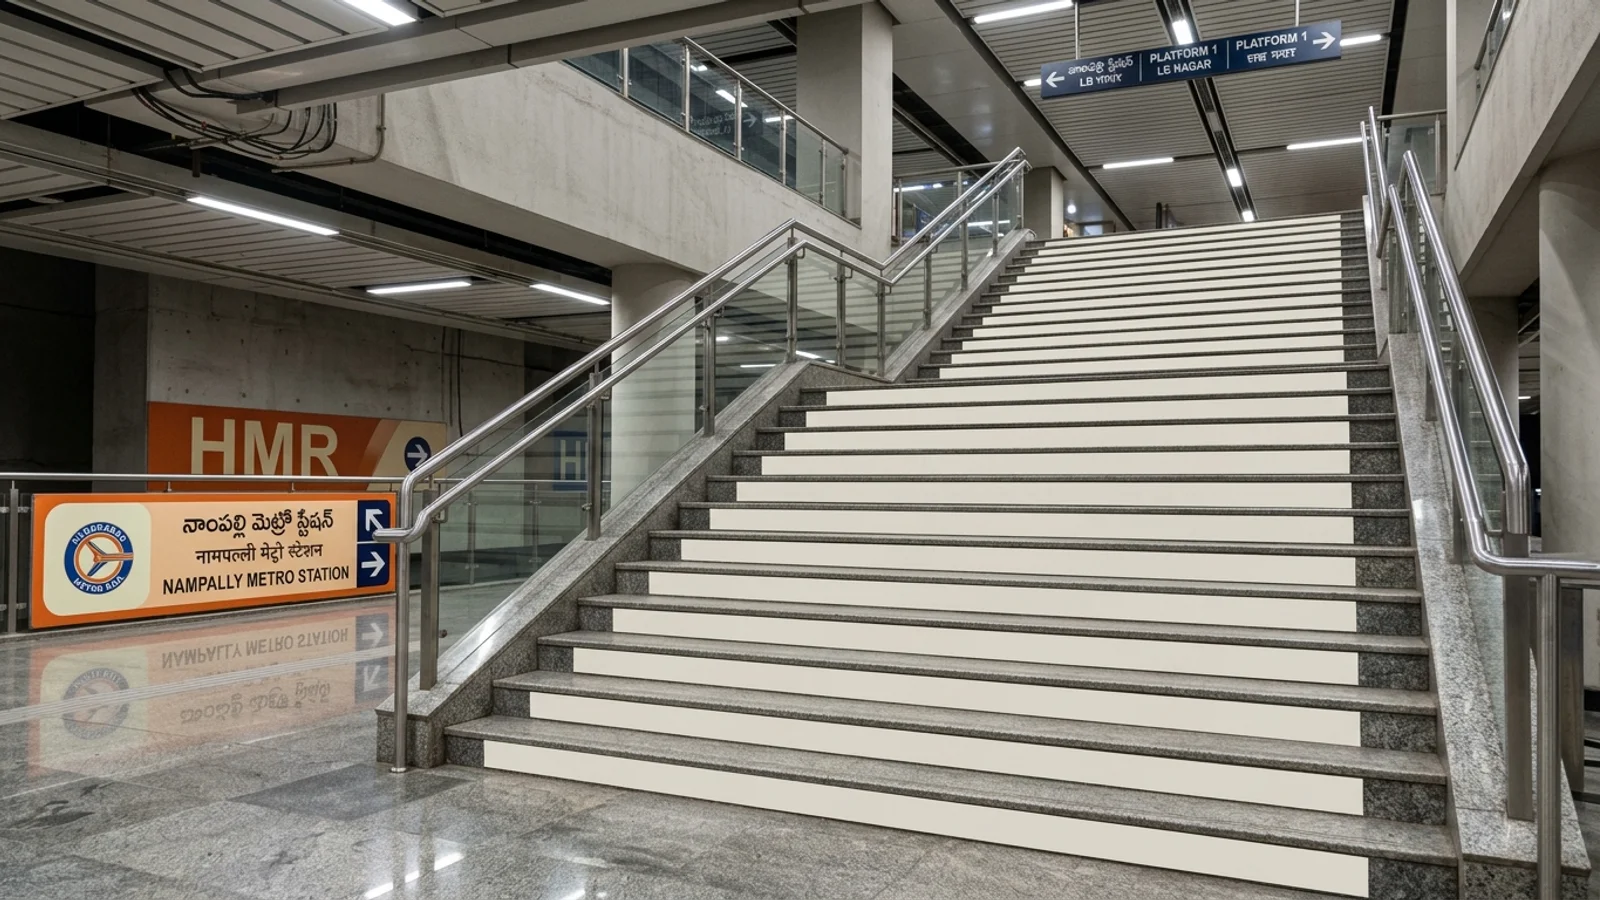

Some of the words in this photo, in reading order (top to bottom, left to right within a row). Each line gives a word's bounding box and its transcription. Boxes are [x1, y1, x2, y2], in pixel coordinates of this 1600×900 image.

[1236, 33, 1298, 51] PLATFORM
[1301, 30, 1307, 41] 1
[1149, 45, 1209, 64] PLATFORM
[1212, 44, 1217, 54] 1
[191, 416, 339, 476] HMR
[182, 513, 246, 538] నాంపల్లి
[162, 573, 243, 595] NAMPALLY
[247, 569, 295, 588] METRO
[298, 565, 349, 583] STATION
